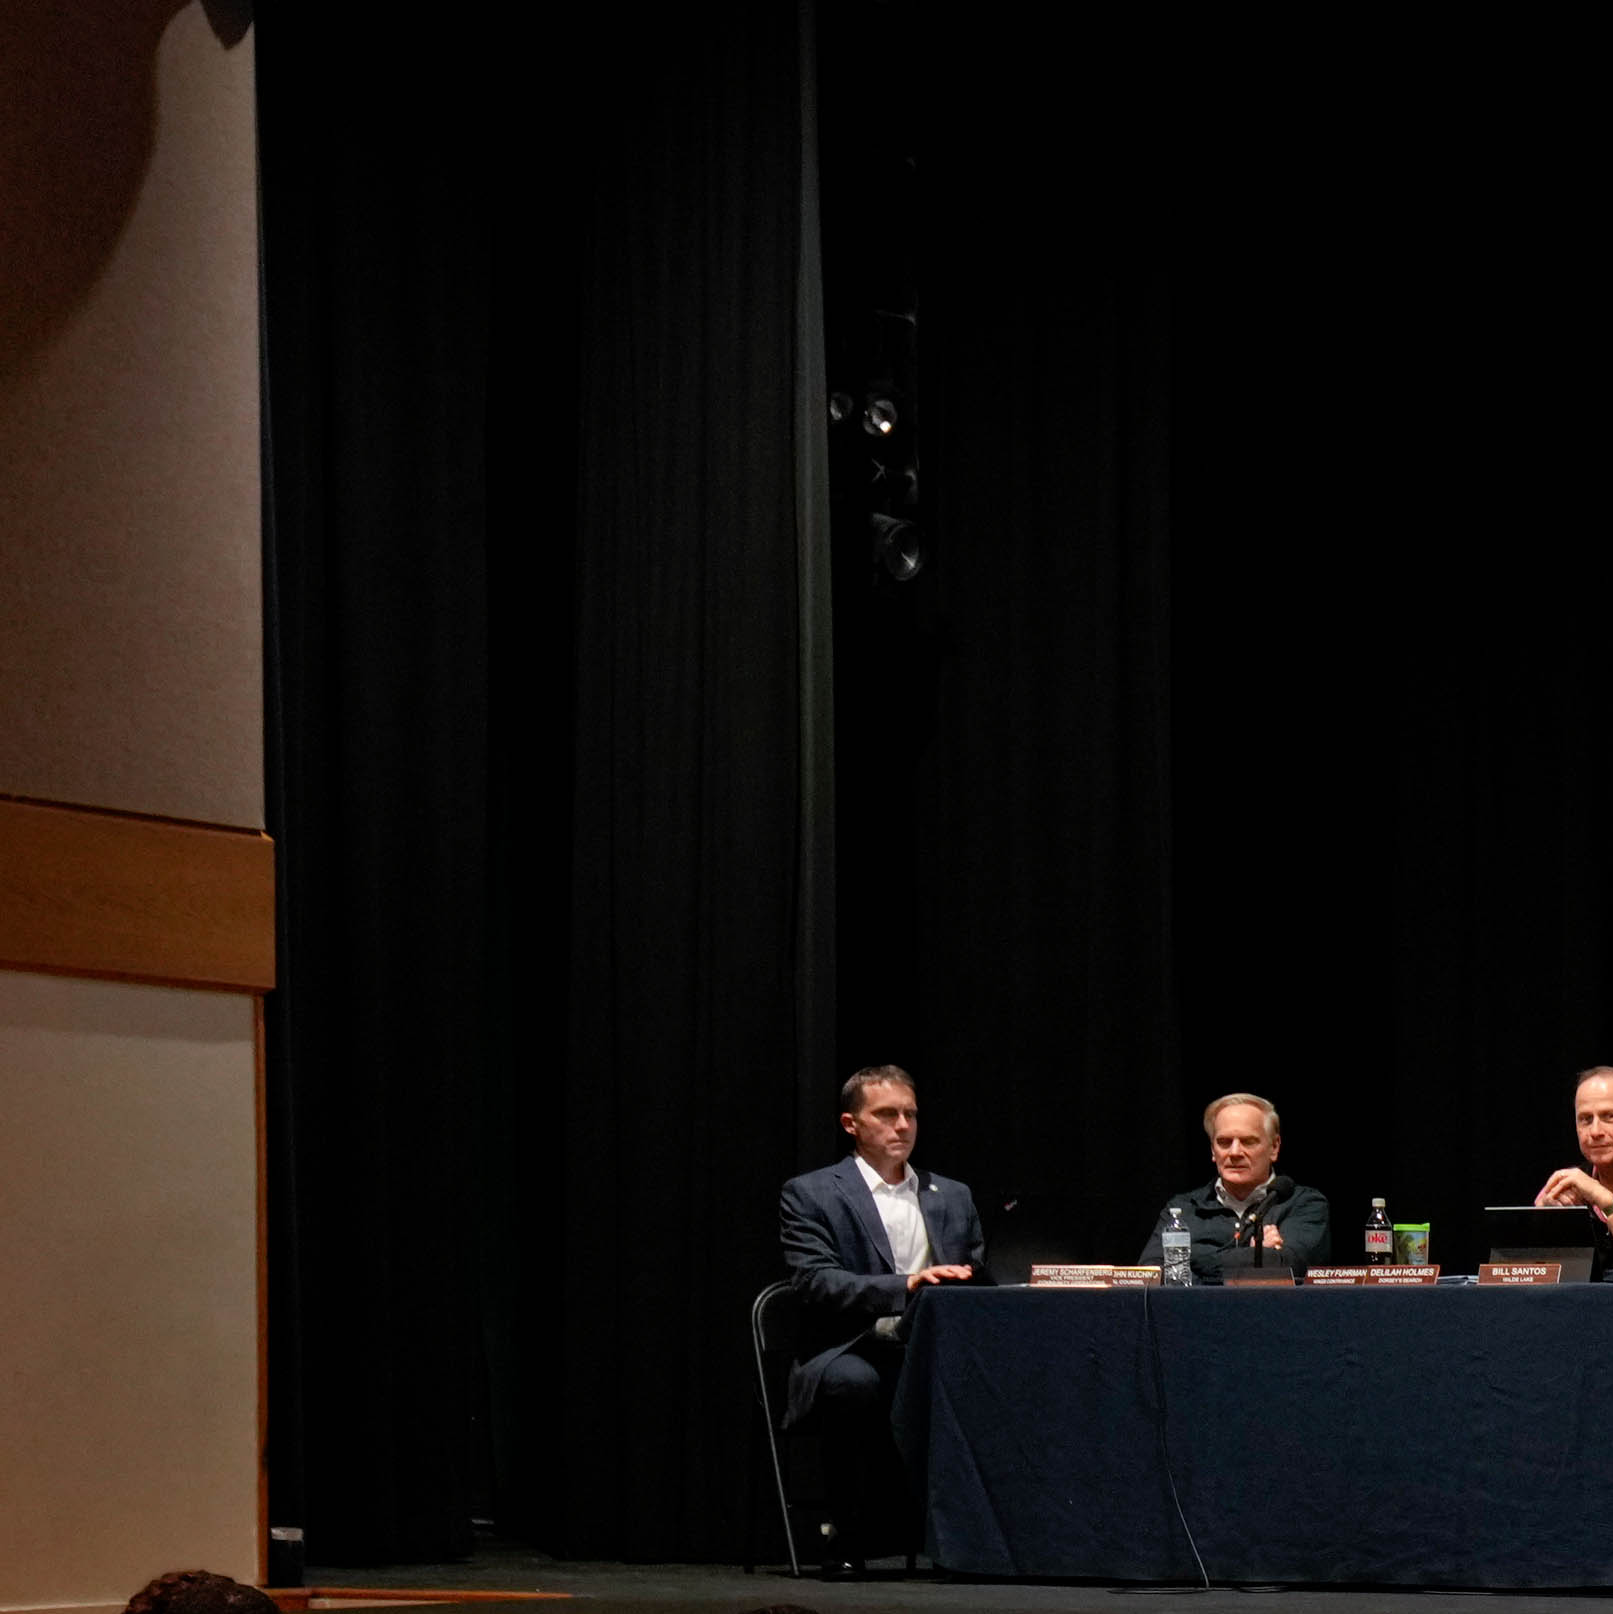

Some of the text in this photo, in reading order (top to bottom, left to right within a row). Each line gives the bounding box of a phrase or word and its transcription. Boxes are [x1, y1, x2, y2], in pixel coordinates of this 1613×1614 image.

[1307, 1269, 1336, 1277] WESLEY
[1370, 1267, 1434, 1276] DELILAH HOLMES
[1492, 1267, 1547, 1276] BILL SANTOS
